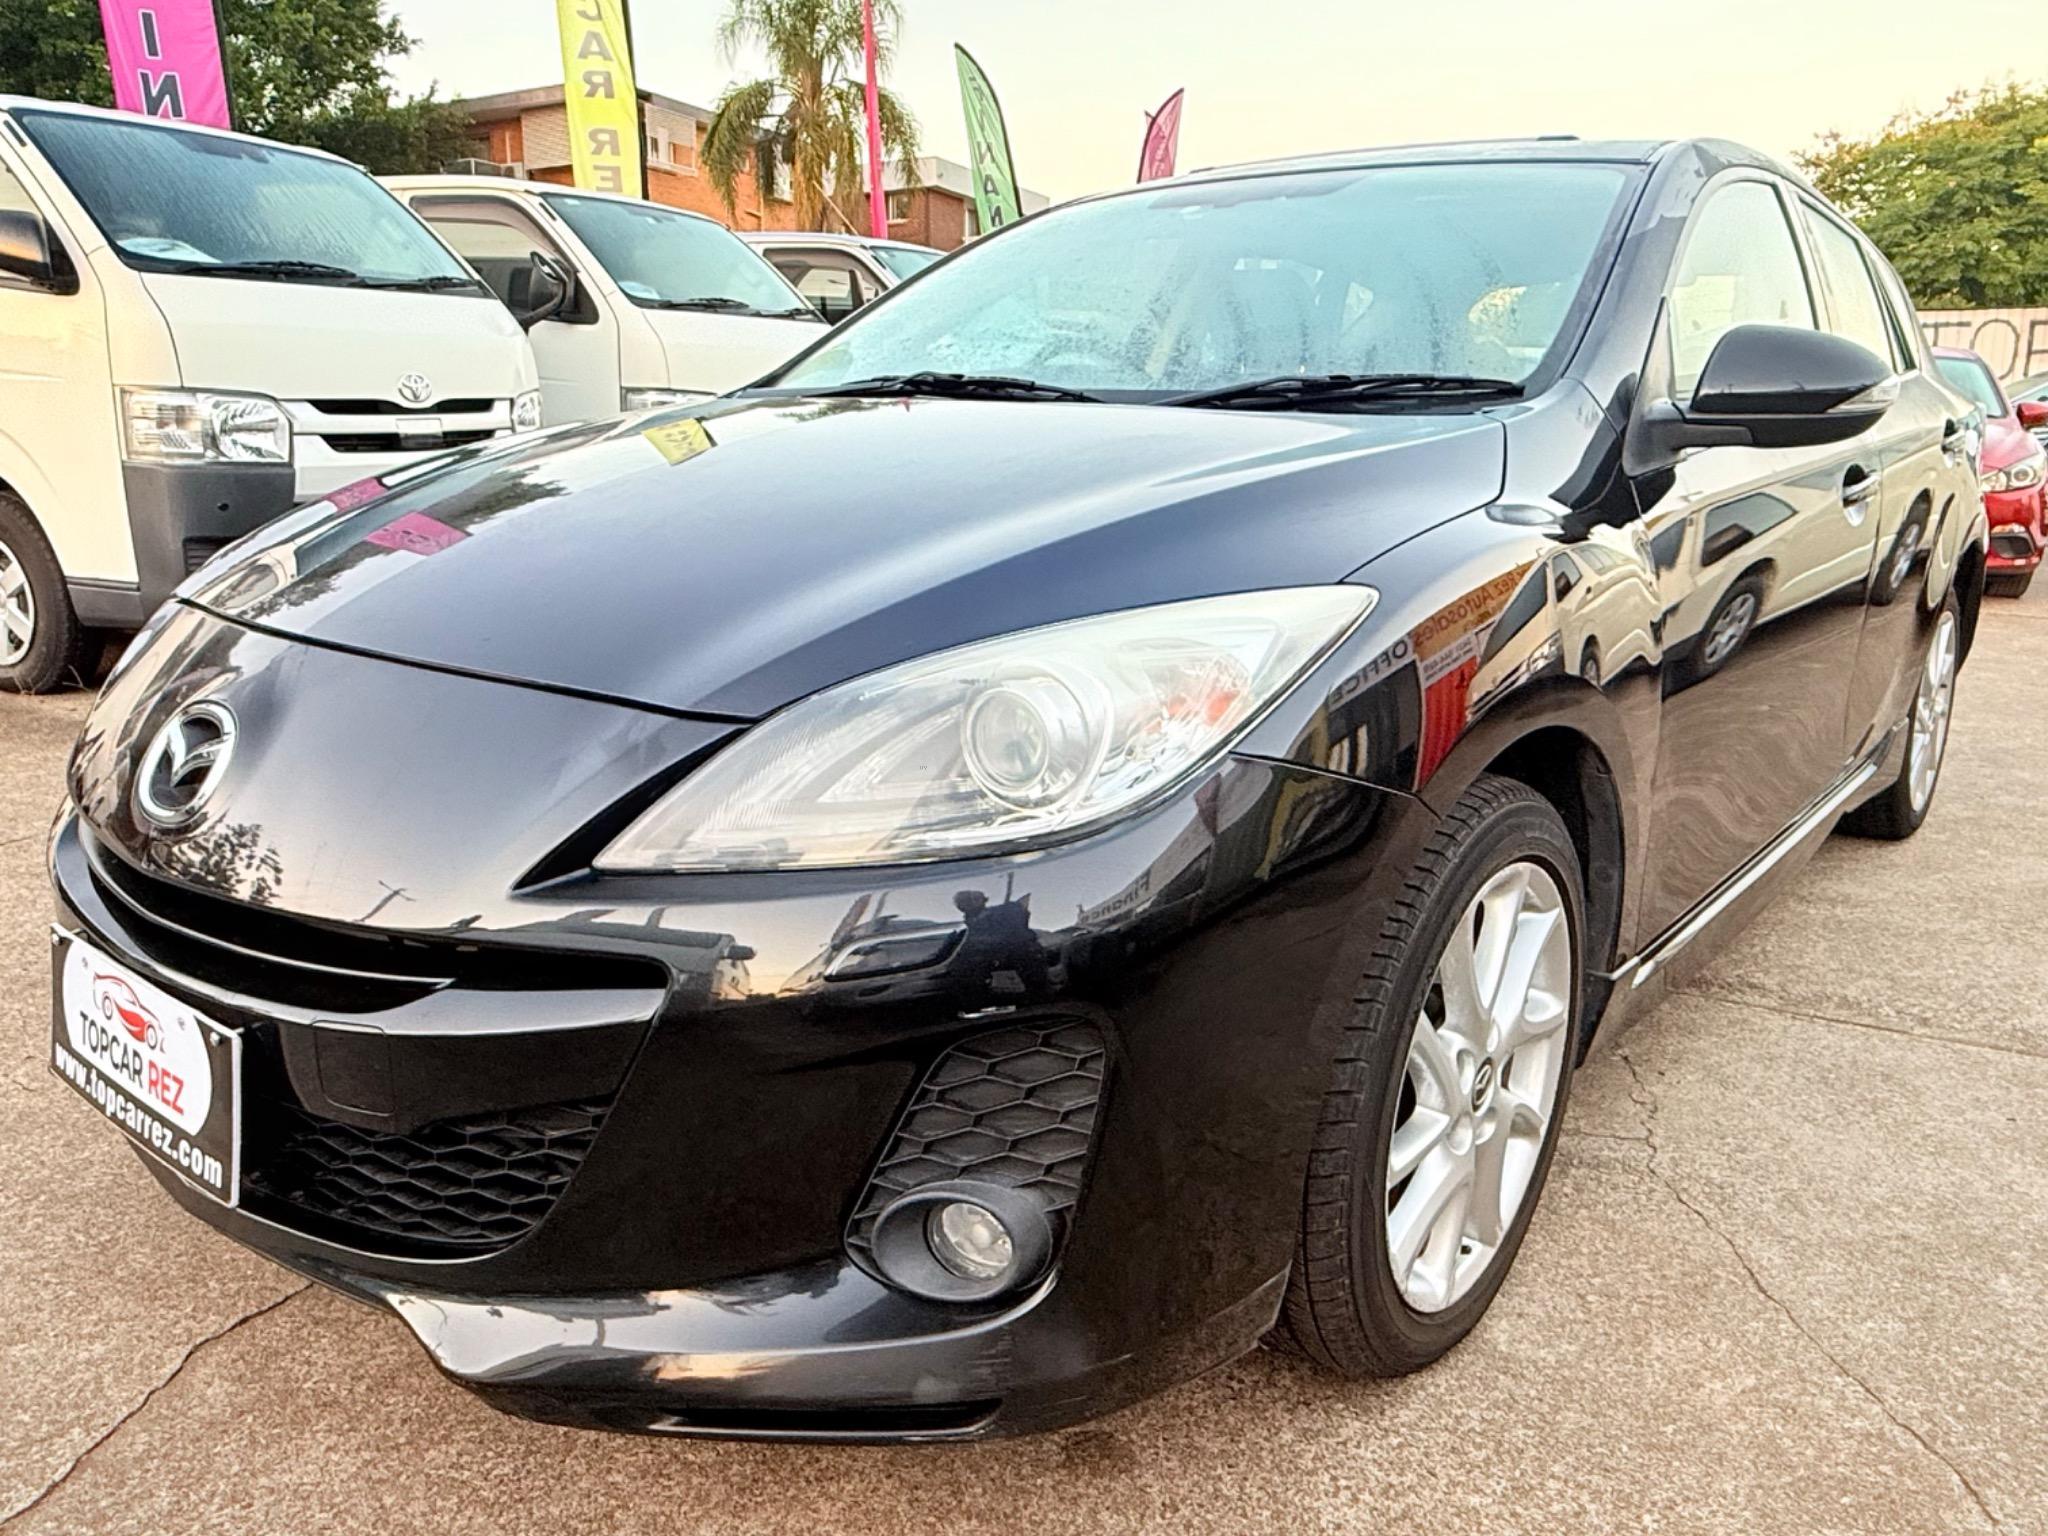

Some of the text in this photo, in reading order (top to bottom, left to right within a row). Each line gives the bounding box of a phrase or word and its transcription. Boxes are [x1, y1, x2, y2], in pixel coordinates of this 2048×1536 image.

[55, 1042, 223, 1188] www.topcarrez.com
[79, 1010, 185, 1115] TOPCAR REZ
